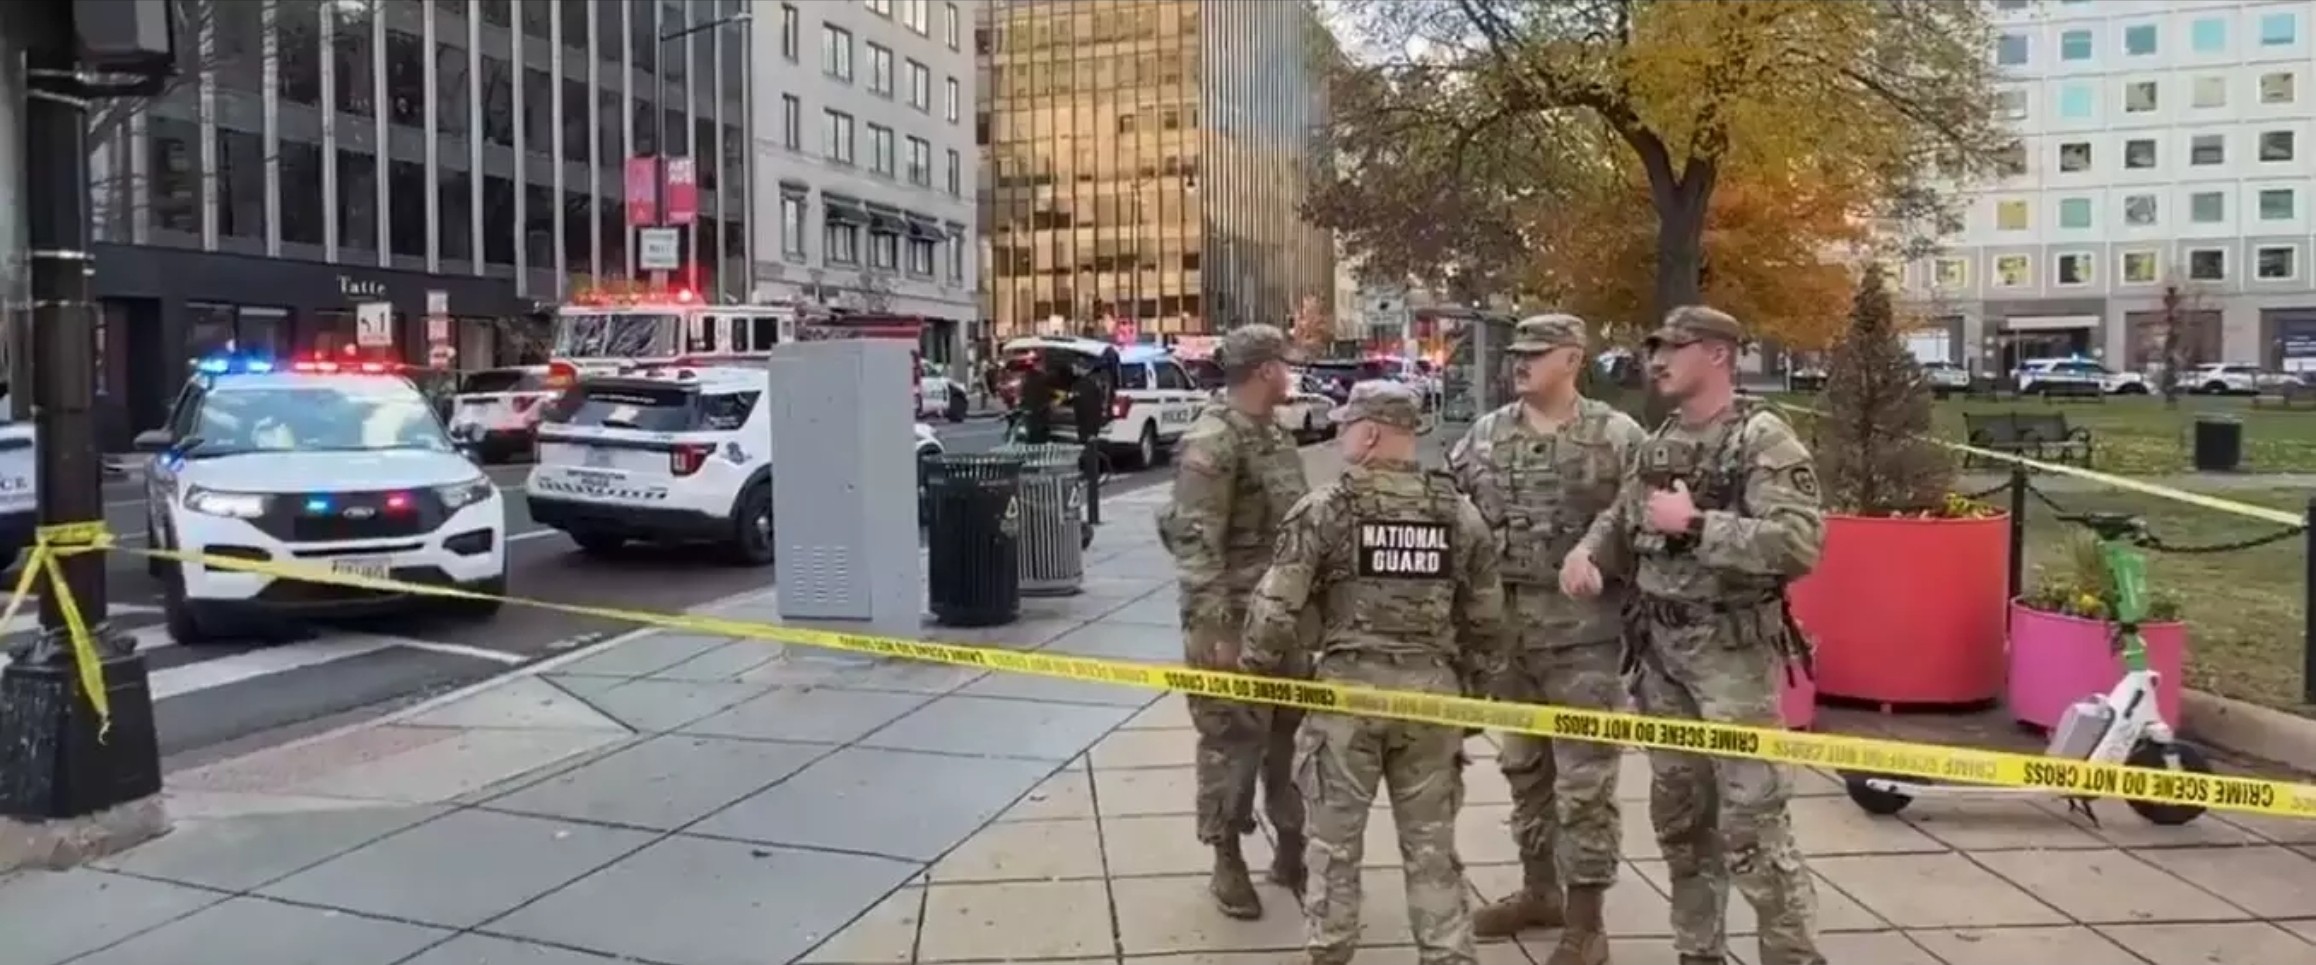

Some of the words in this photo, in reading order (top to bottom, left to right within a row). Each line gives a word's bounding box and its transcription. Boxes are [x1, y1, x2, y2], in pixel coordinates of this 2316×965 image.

[336, 274, 387, 296] Tatte
[1362, 525, 1450, 549] NATIONAL
[1372, 550, 1440, 573] GUARD
[1207, 676, 1231, 693] NOT
[1253, 680, 1291, 701] SCENE
[1295, 685, 1337, 706] CRIME
[1554, 713, 1599, 738] CROSS
[1603, 717, 1632, 740] NOT
[1635, 722, 1655, 743] DO
[1660, 723, 1706, 748] SCENE
[1711, 729, 1760, 753] CRIME
[2023, 761, 2079, 788] CROSS
[2082, 767, 2117, 792] NOT
[2122, 771, 2147, 796] DO
[2152, 773, 2208, 801] SCENE
[2214, 780, 2274, 807] CRIME
